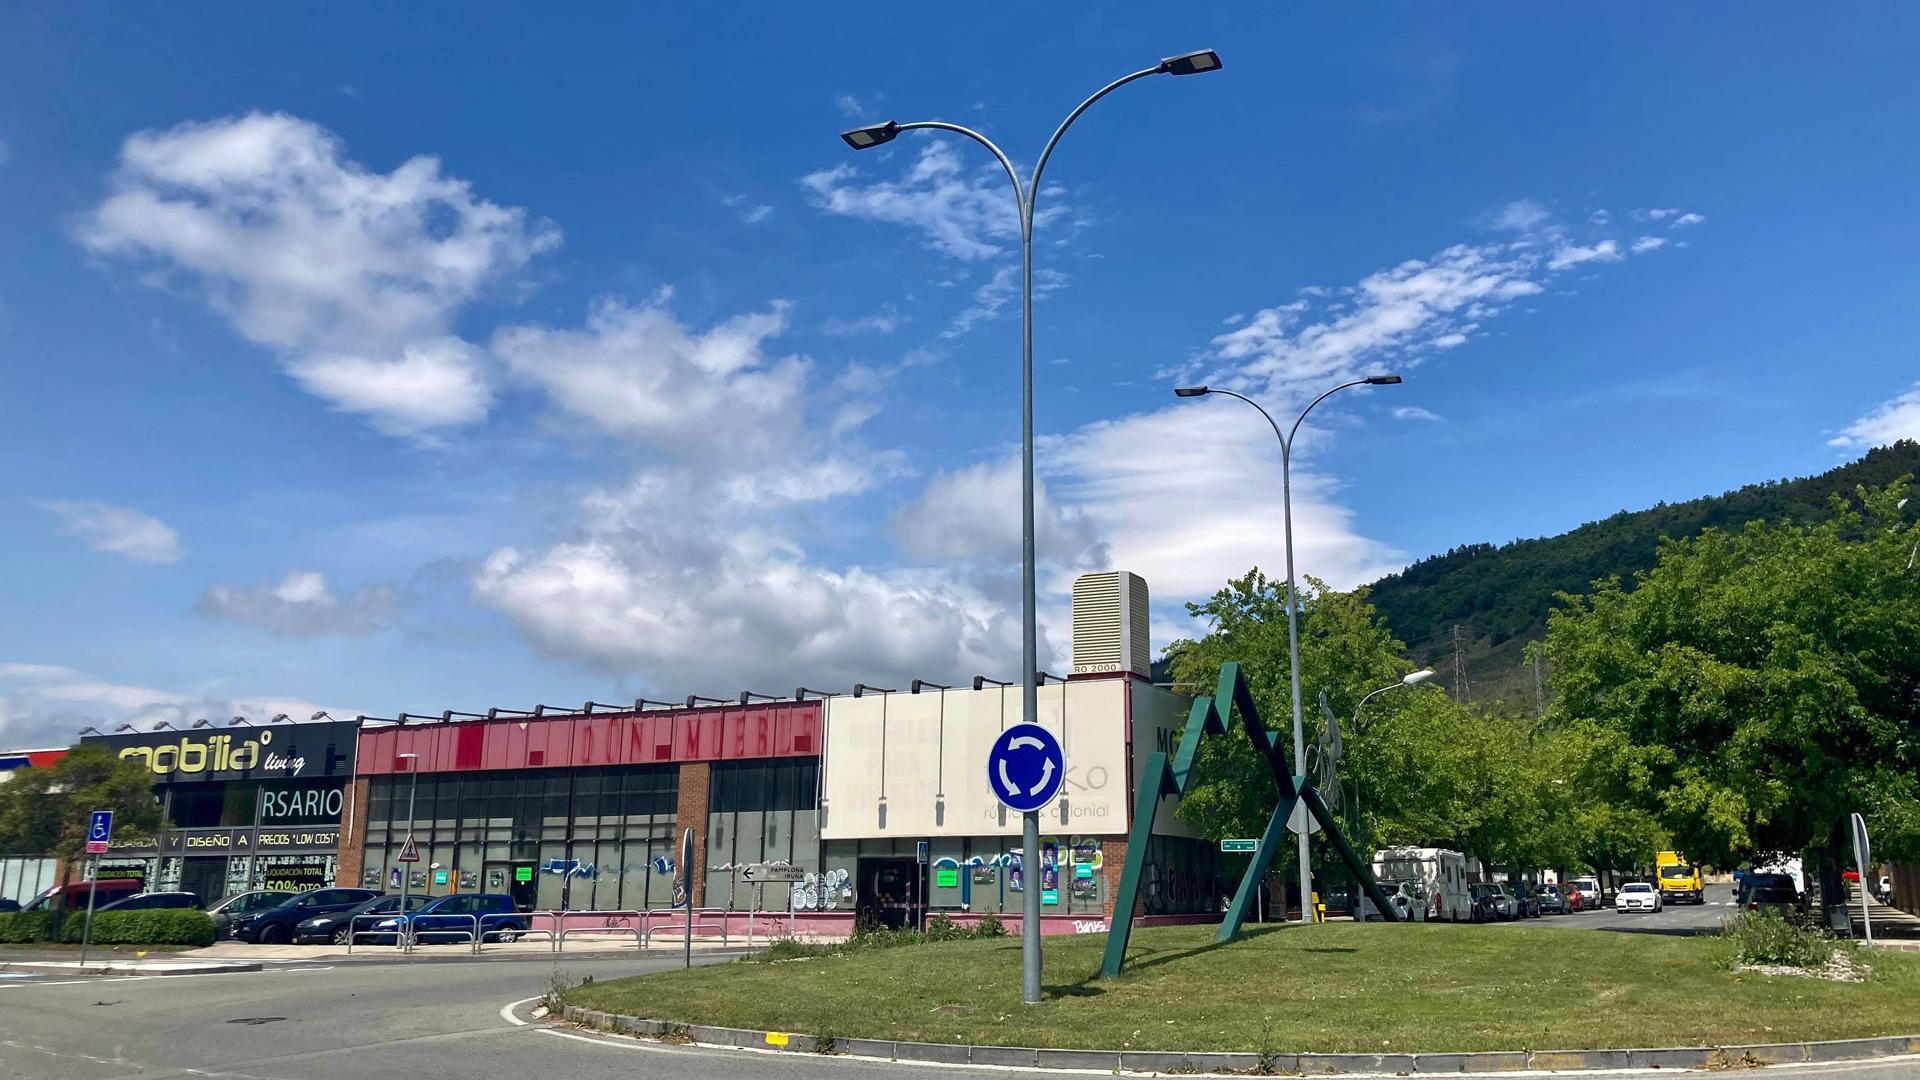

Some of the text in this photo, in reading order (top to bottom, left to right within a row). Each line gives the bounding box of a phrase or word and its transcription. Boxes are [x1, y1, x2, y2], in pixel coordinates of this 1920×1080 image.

[1074, 664, 1117, 673] RO 2000
[264, 751, 306, 776] living
[262, 789, 343, 817] RSARIO
[171, 837, 179, 847] Y
[187, 834, 230, 847] DISEÑO
[237, 834, 248, 846] A
[303, 867, 323, 876] TOTAL
